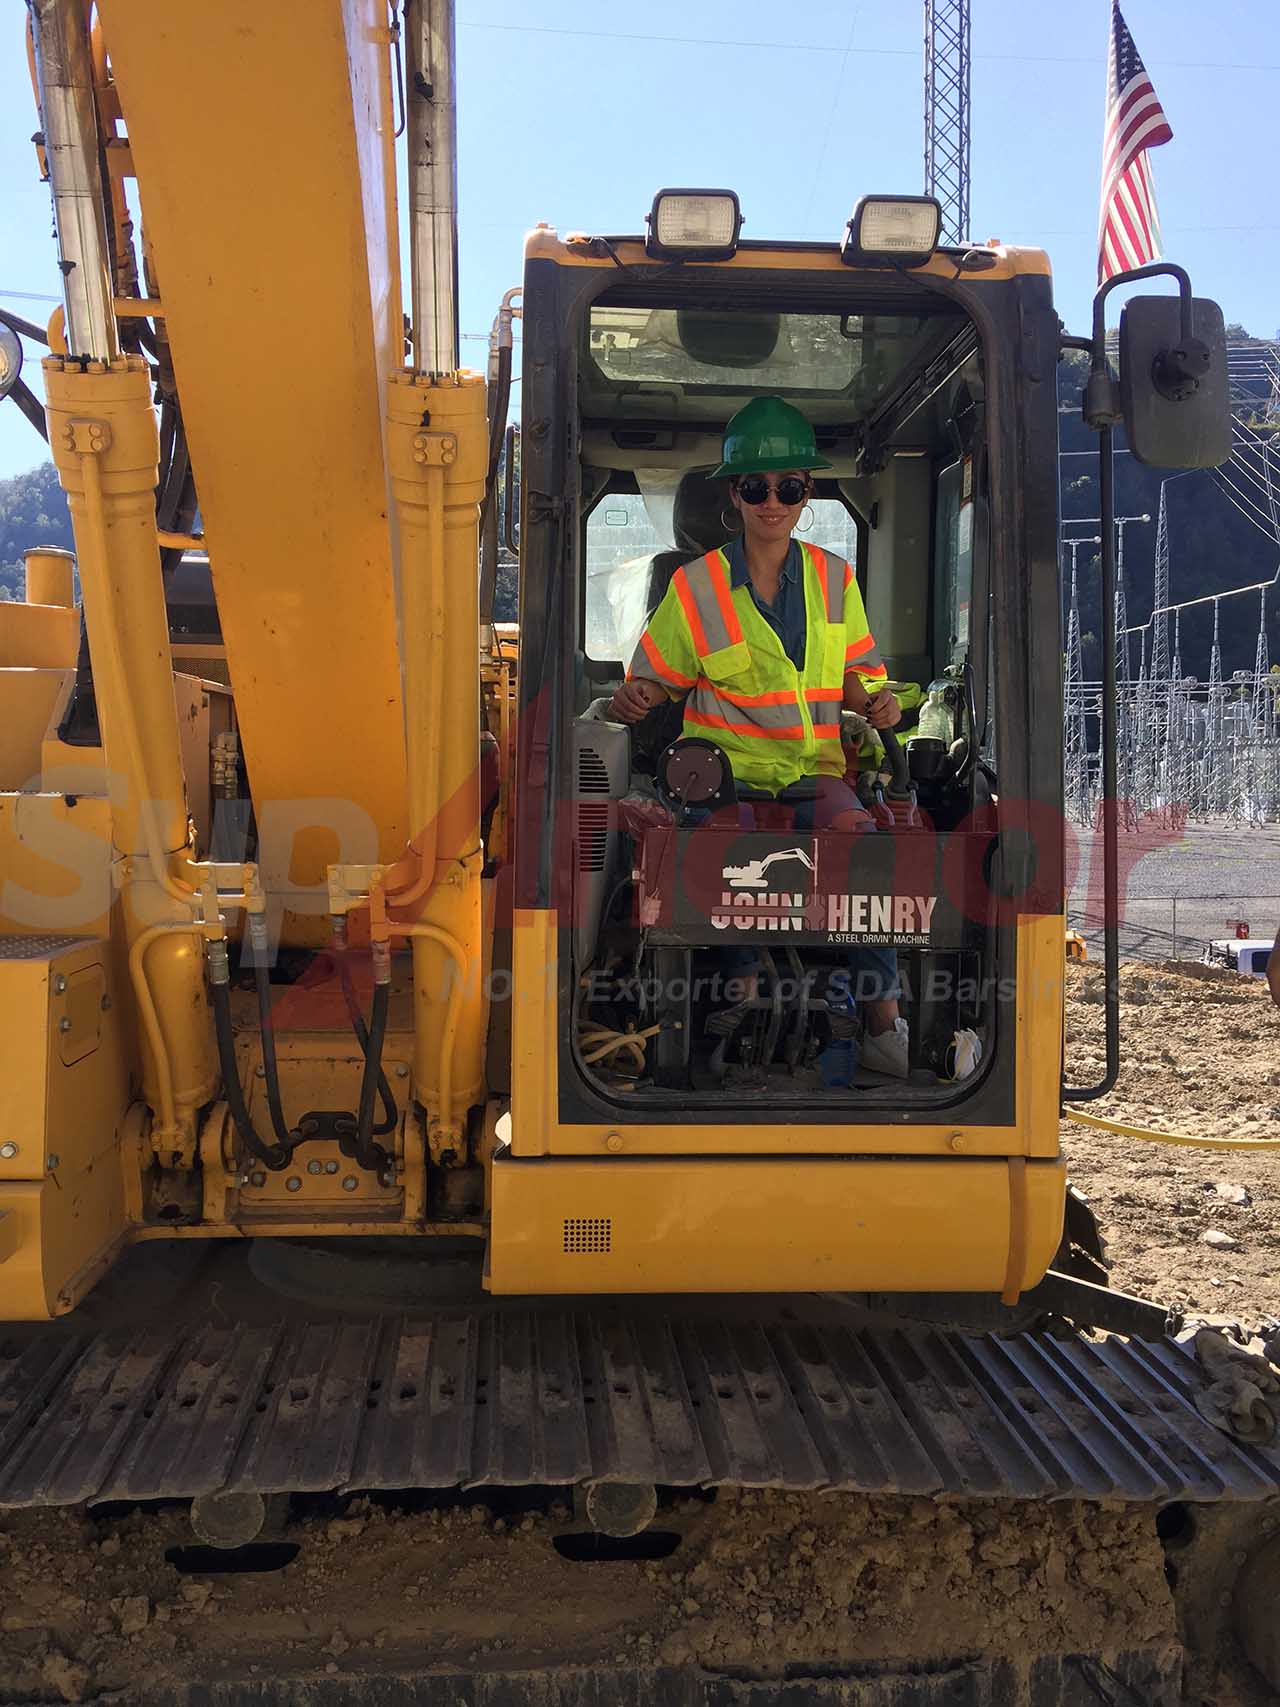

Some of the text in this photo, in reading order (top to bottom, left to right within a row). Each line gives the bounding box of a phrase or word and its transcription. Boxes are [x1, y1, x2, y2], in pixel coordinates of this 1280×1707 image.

[711, 892, 937, 933] JOHN HENRY
[827, 934, 834, 943] A
[835, 934, 860, 944] STEEL
[893, 935, 931, 945] MACHINE
